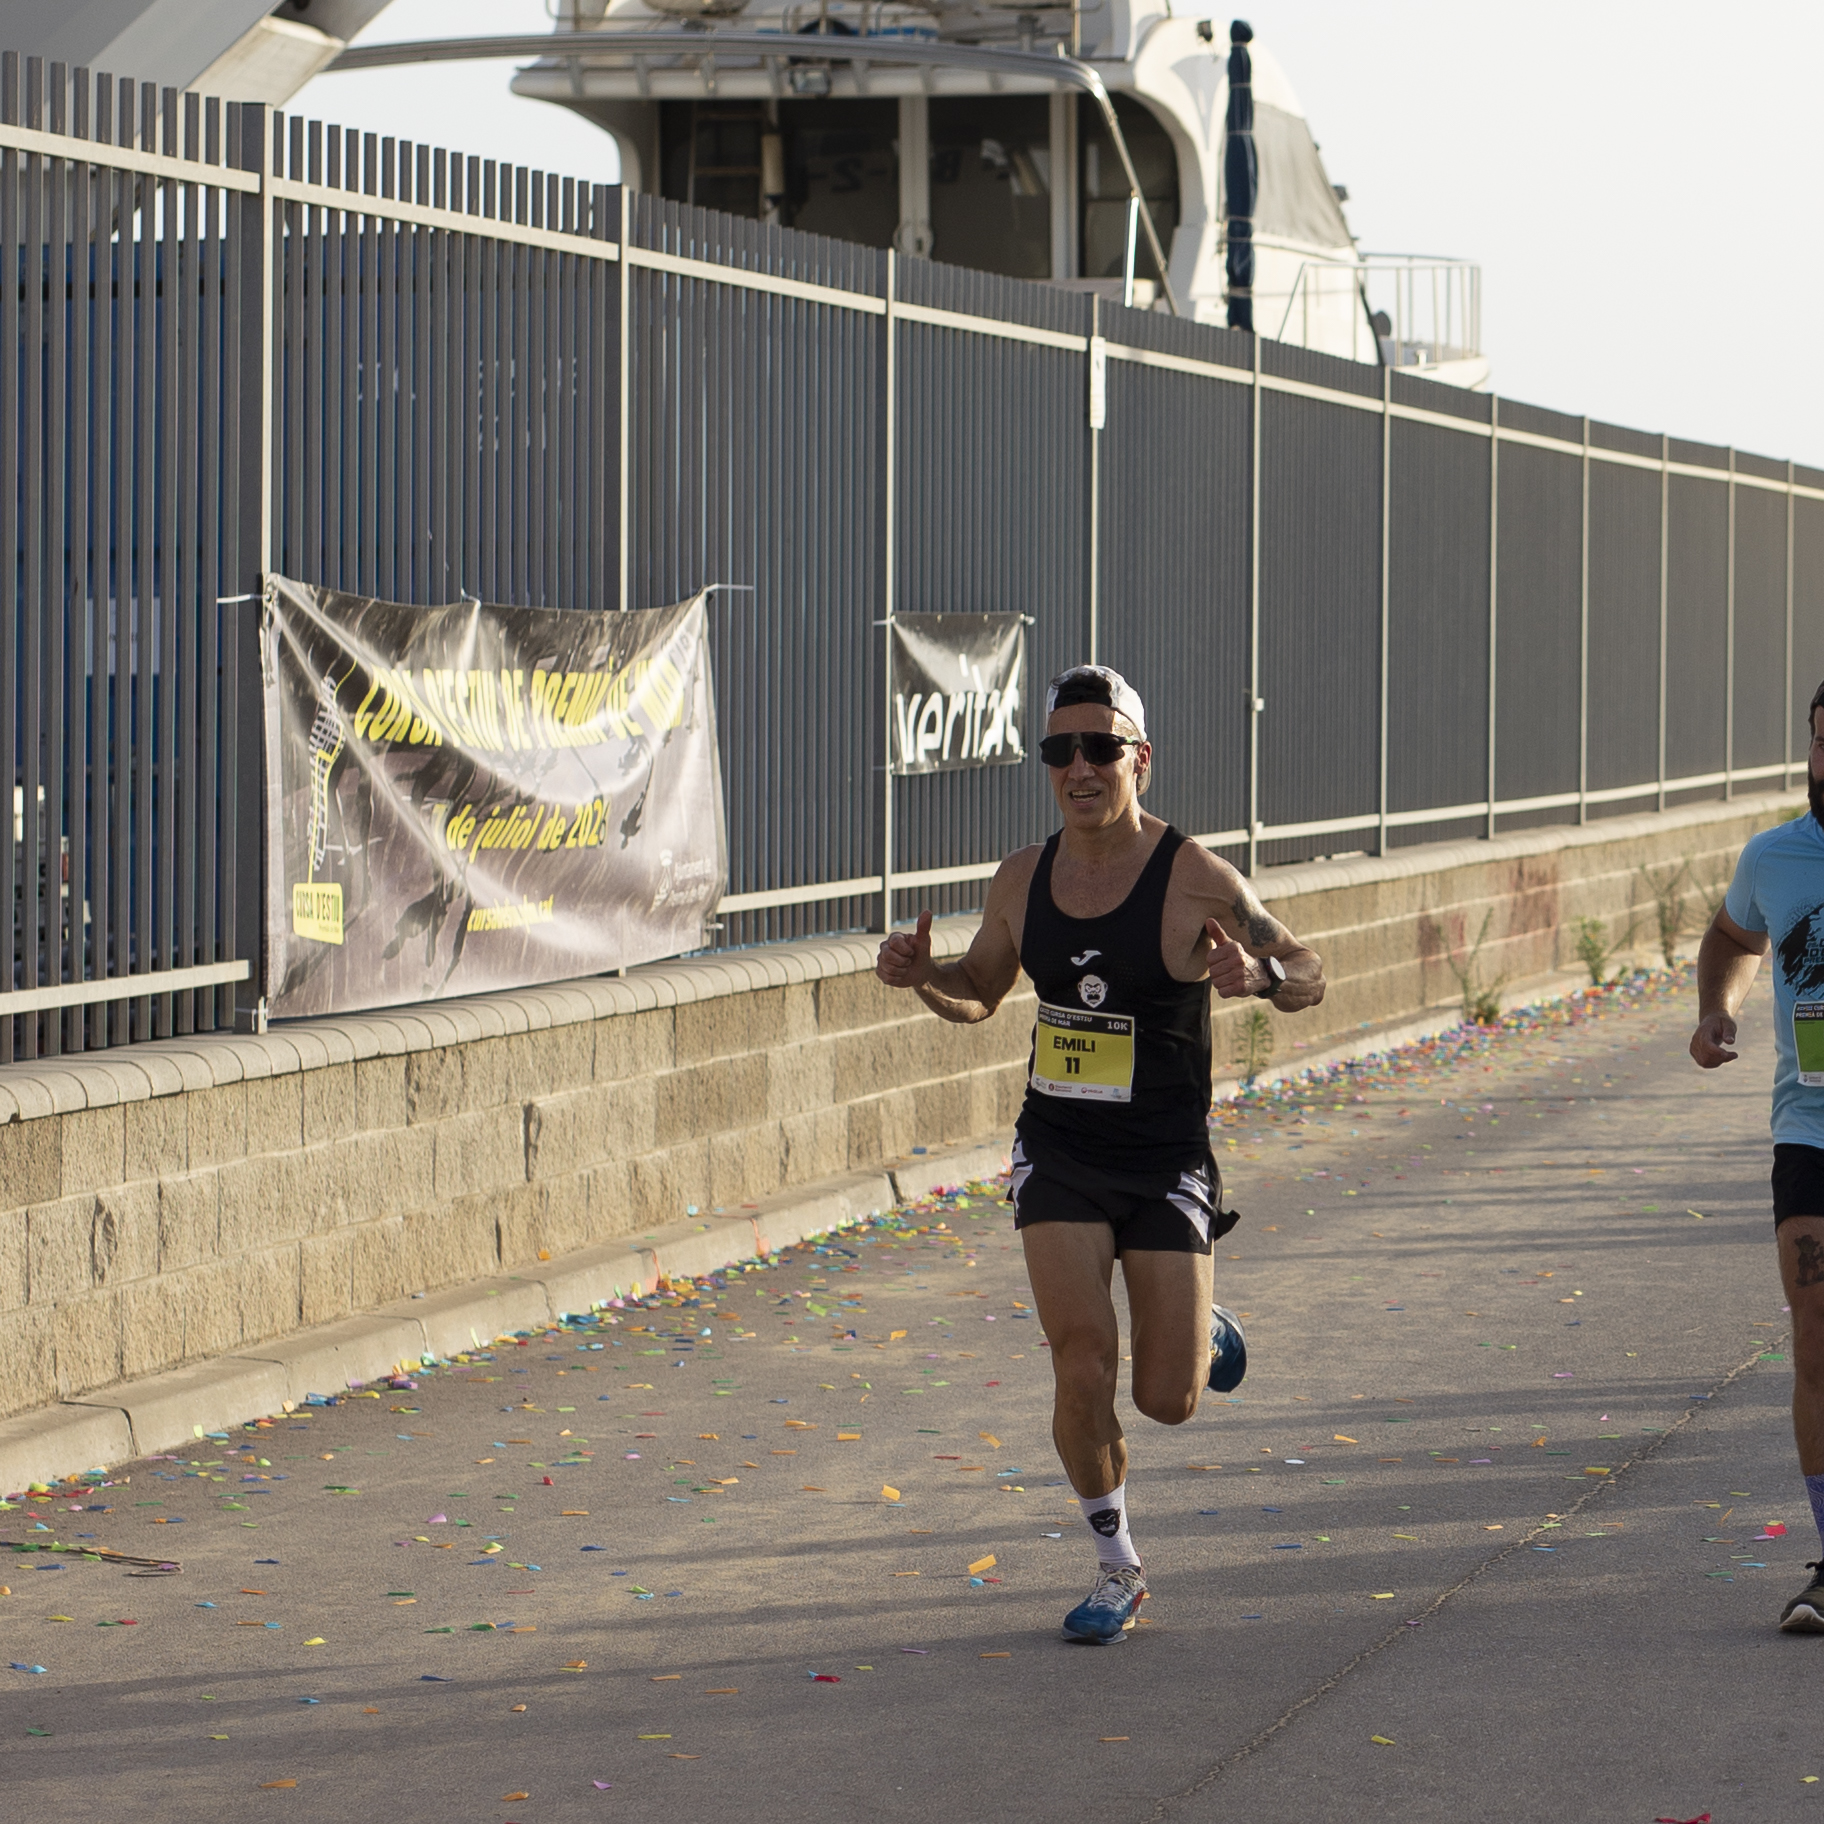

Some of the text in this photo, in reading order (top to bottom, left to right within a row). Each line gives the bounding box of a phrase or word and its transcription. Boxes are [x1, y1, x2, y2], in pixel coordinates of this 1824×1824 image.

[355, 663, 443, 747] CURSA
[501, 668, 533, 753] DE
[606, 664, 643, 740] DE
[896, 653, 1020, 763] veritas
[446, 804, 477, 851] de
[469, 804, 545, 864] juliol
[537, 804, 566, 850] de
[1053, 1035, 1096, 1053] EMILI
[1107, 1020, 1129, 1031] 10K
[1065, 1056, 1080, 1074] 11
